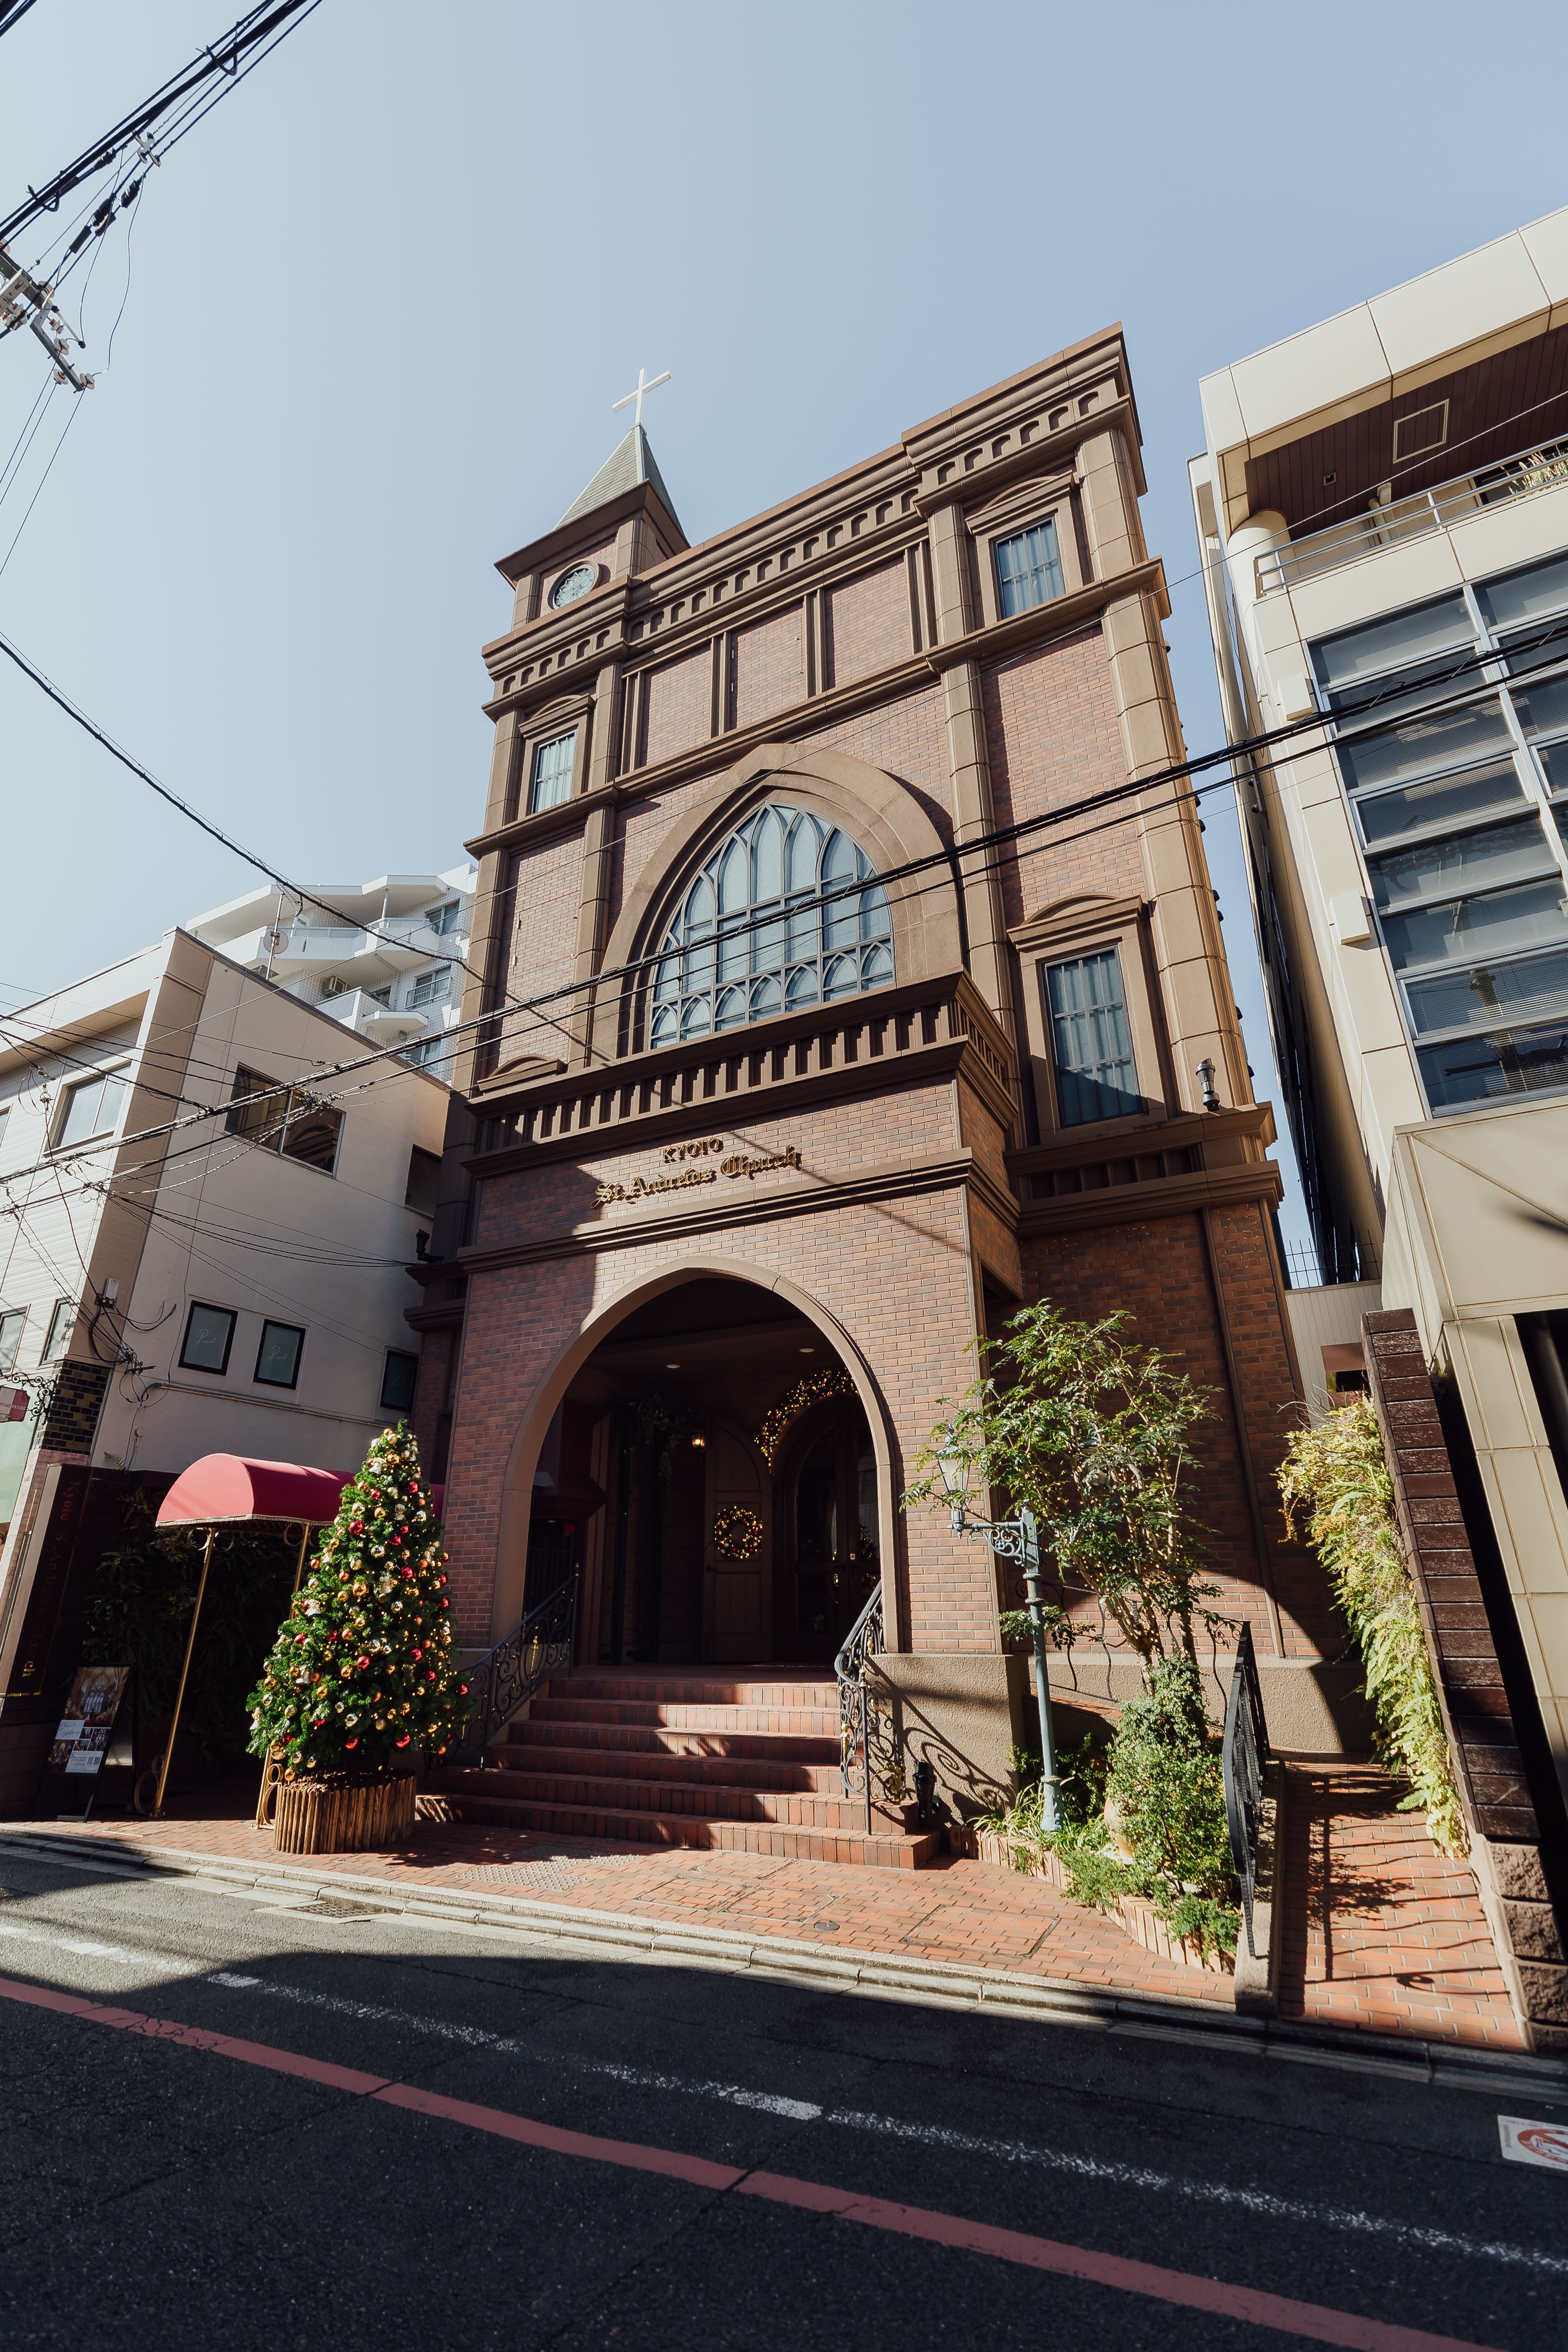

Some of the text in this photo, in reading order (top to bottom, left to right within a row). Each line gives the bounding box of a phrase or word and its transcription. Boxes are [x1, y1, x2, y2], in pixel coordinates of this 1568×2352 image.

[661, 1137, 719, 1161] KYOTO
[720, 1144, 797, 1177] Church
[61, 1482, 80, 1521] Kyoto
